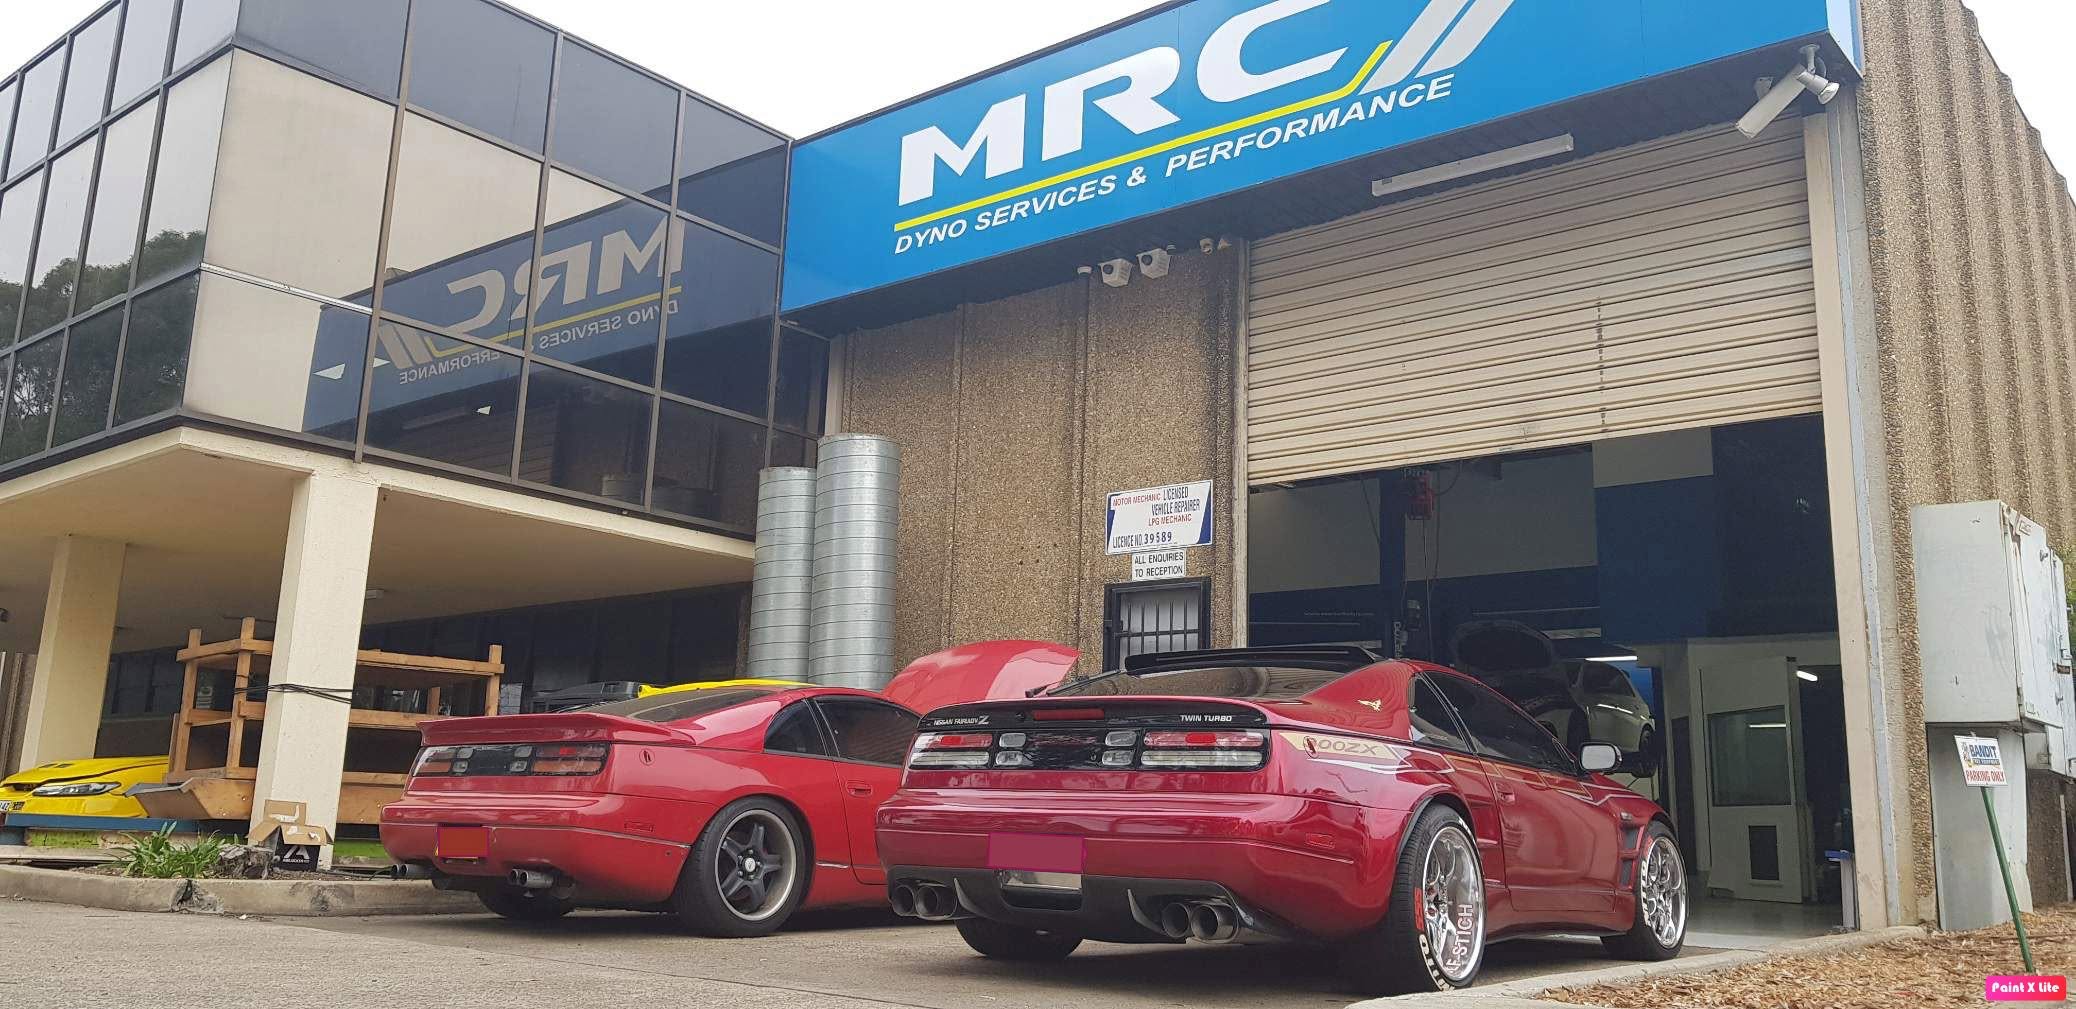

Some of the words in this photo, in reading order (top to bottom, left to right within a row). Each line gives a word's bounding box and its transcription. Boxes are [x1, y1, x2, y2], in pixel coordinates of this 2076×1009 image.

[898, 0, 1349, 206] MRC
[895, 219, 967, 254] DYNO
[975, 174, 1118, 231] SERVICES
[1126, 166, 1147, 187] &
[1165, 74, 1455, 177] PERFORMANCE
[1112, 496, 1132, 507] MOTOR
[1132, 493, 1161, 504] MECHANIC
[1163, 486, 1189, 501] LICENSED
[1151, 502, 1173, 516] VEHICLE
[1173, 499, 1201, 513] REPAIRER
[1148, 518, 1160, 527] LPG
[1160, 514, 1192, 525] MECHANIC
[1134, 555, 1146, 565] ALL
[1148, 552, 1184, 564] ENQUIRIES
[1135, 568, 1144, 578] TO
[1146, 565, 1183, 577] RECEPTION
[1180, 714, 1202, 722] TWIN
[1969, 744, 1997, 758] BANDIT
[1966, 770, 1990, 782] PARKING
